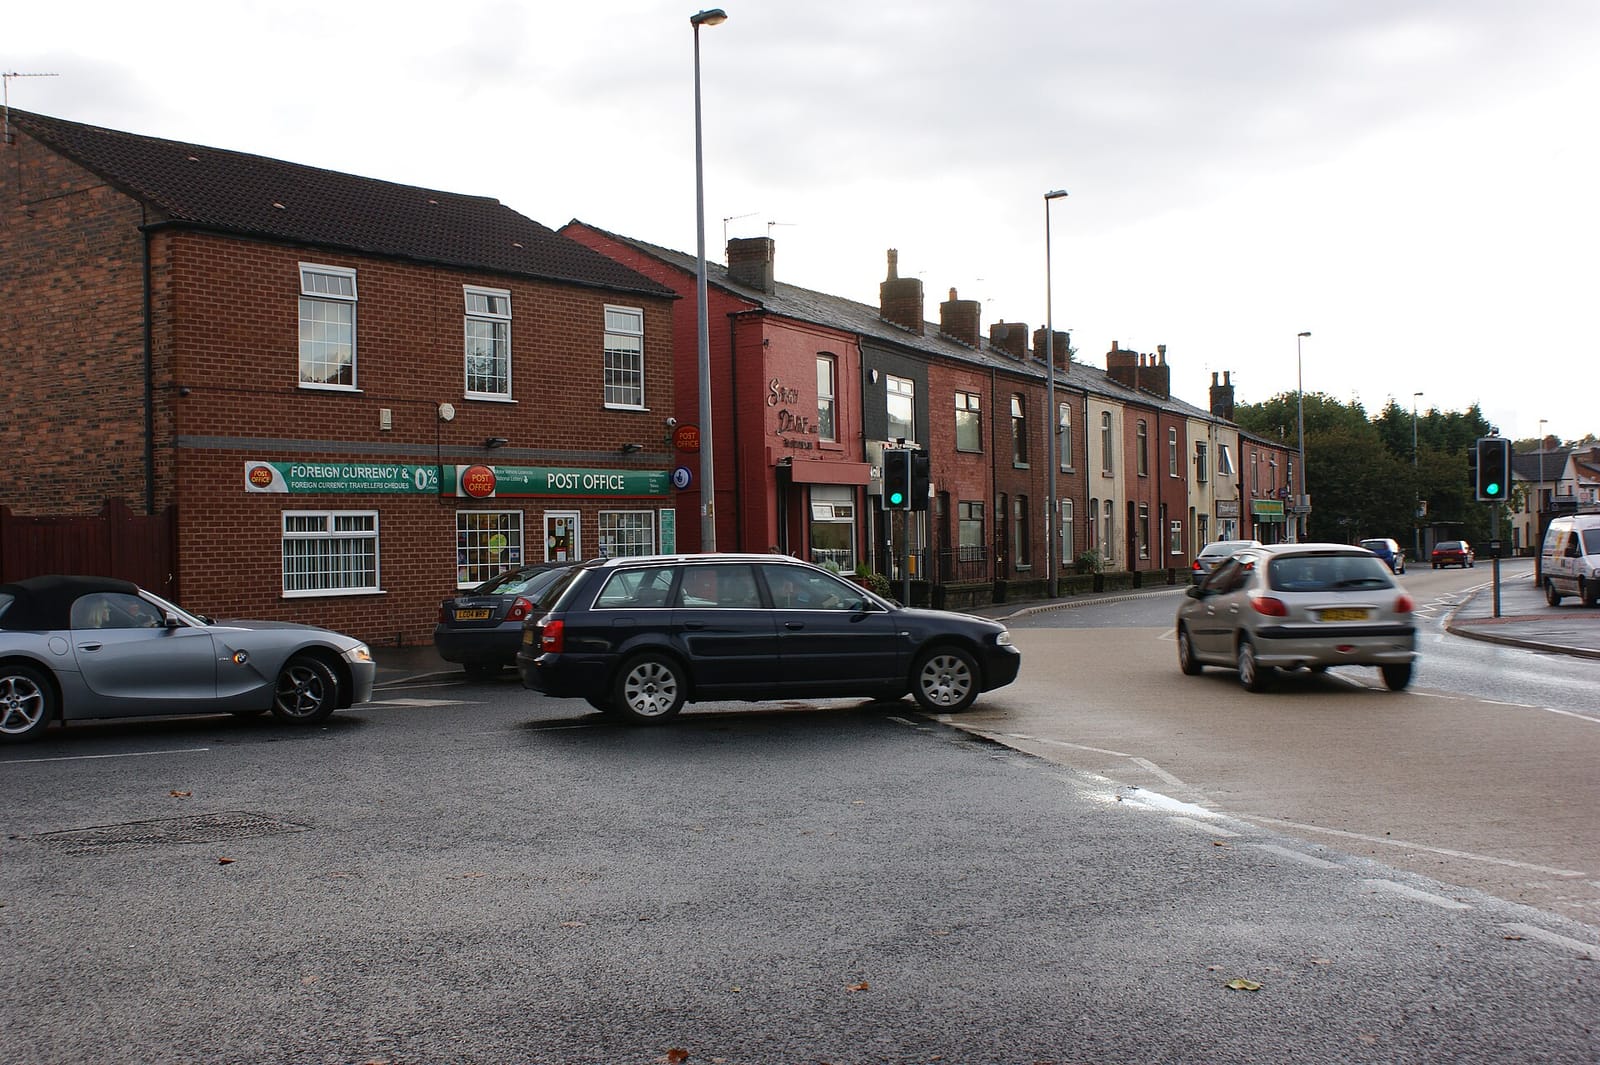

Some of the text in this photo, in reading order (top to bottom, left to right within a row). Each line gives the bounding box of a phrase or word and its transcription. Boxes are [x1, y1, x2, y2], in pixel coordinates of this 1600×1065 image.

[680, 432, 697, 440] POST
[676, 440, 699, 448] OFFICE
[291, 466, 410, 479] FOREIGN CURRENCY &
[471, 474, 490, 482] POST
[547, 473, 625, 490] POST OFFICE
[291, 481, 410, 490] FOREIGN CURRENCY TRAVELLERS CHEQUES
[469, 483, 493, 492] OFFICE
